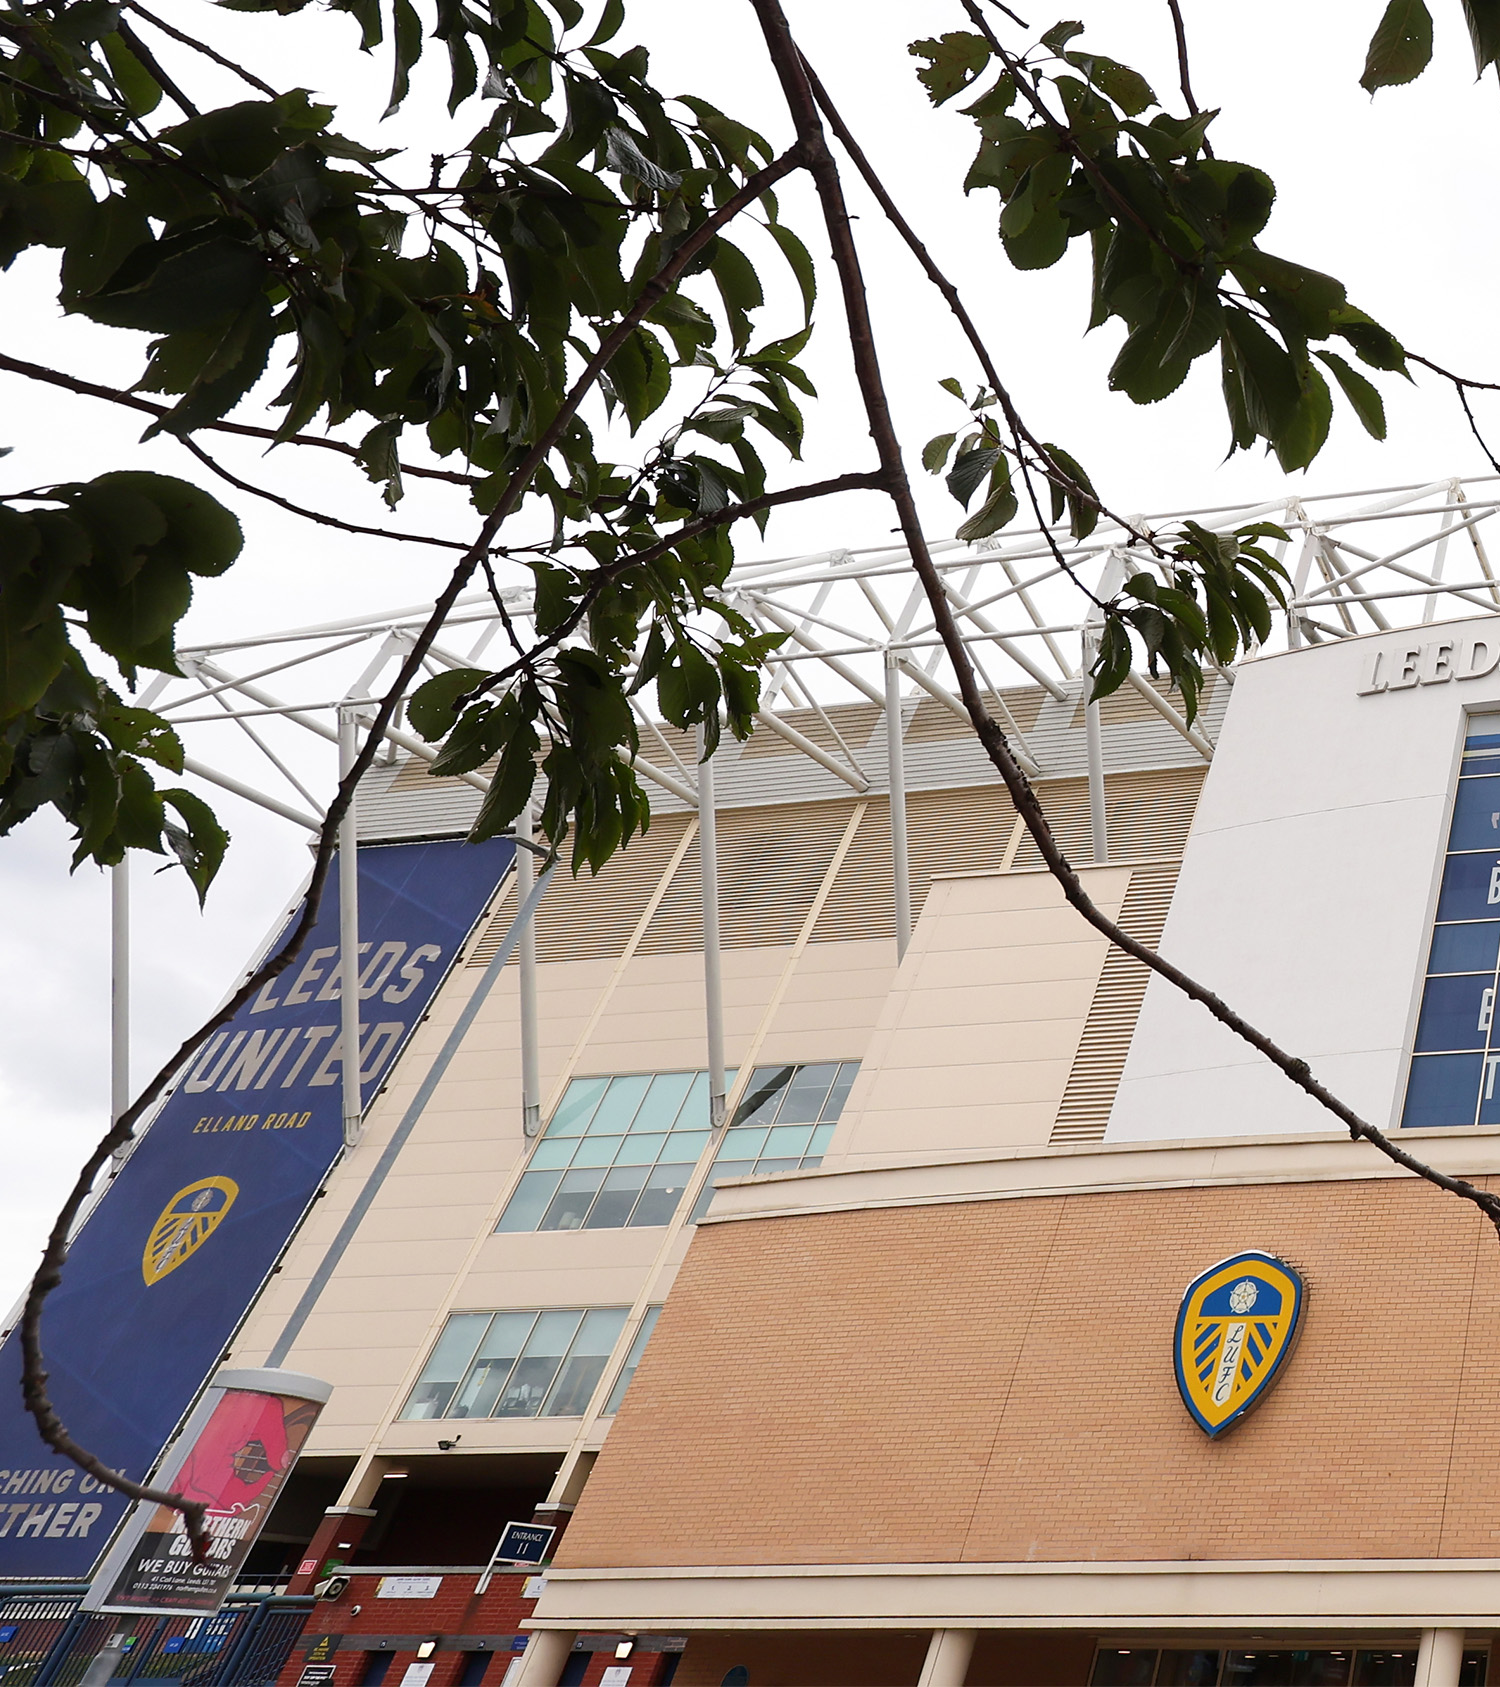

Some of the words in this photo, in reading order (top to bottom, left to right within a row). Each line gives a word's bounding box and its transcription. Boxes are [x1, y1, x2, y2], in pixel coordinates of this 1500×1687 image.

[249, 941, 442, 1015] LEEDS
[183, 1022, 406, 1094] UNITED
[192, 1114, 259, 1134] ELLAND
[261, 1111, 313, 1130] ROAD
[1215, 1324, 1244, 1402] LUFC
[0, 1503, 103, 1538] THER
[169, 1513, 252, 1540] NRTHERN
[168, 1534, 237, 1560] GUARS
[511, 1530, 544, 1542] ENTRANCE
[137, 1558, 165, 1573] WE
[162, 1560, 193, 1574] BUY
